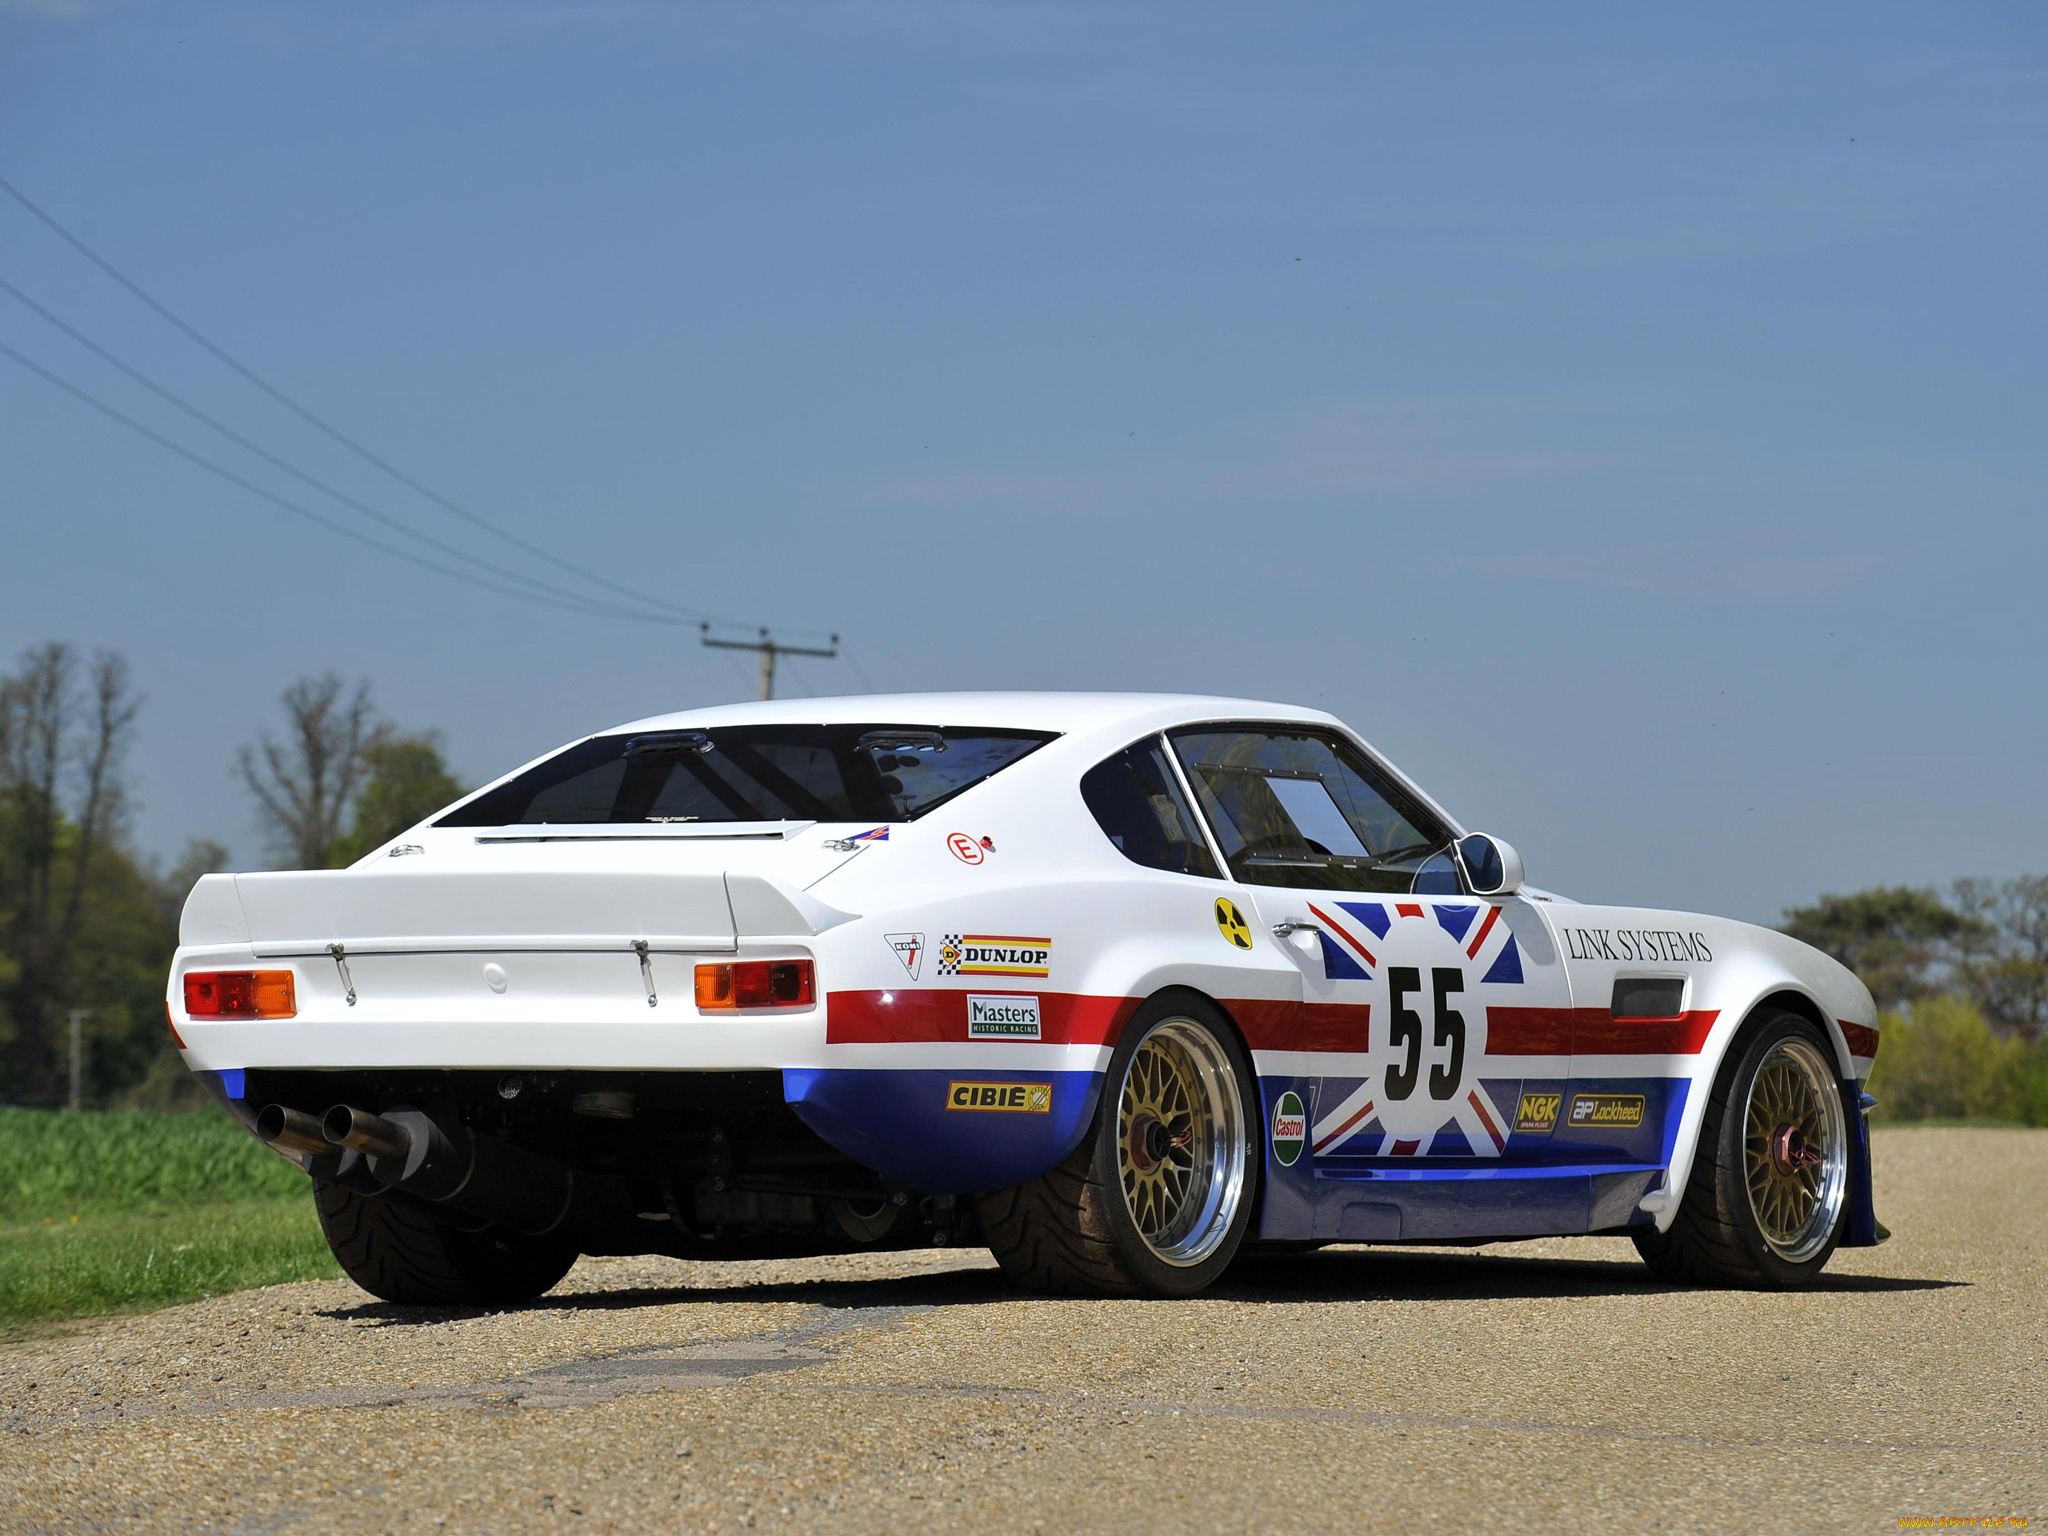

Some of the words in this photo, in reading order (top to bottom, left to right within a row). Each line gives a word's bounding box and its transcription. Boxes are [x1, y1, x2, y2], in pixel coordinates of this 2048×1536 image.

[953, 838, 978, 859] E
[896, 942, 920, 950] KONI
[1563, 928, 1620, 960] LINK
[1617, 929, 1713, 962] SYSTEMS
[965, 948, 1048, 964] DUNLOP
[972, 1001, 1036, 1023] Masters
[973, 1024, 1007, 1033] HISTORIC
[1010, 1025, 1037, 1034] RACING
[1384, 966, 1466, 1101] 55
[1520, 1097, 1559, 1121] NGK
[1592, 1101, 1641, 1121] Lockheed
[1275, 1117, 1304, 1137] Castrol
